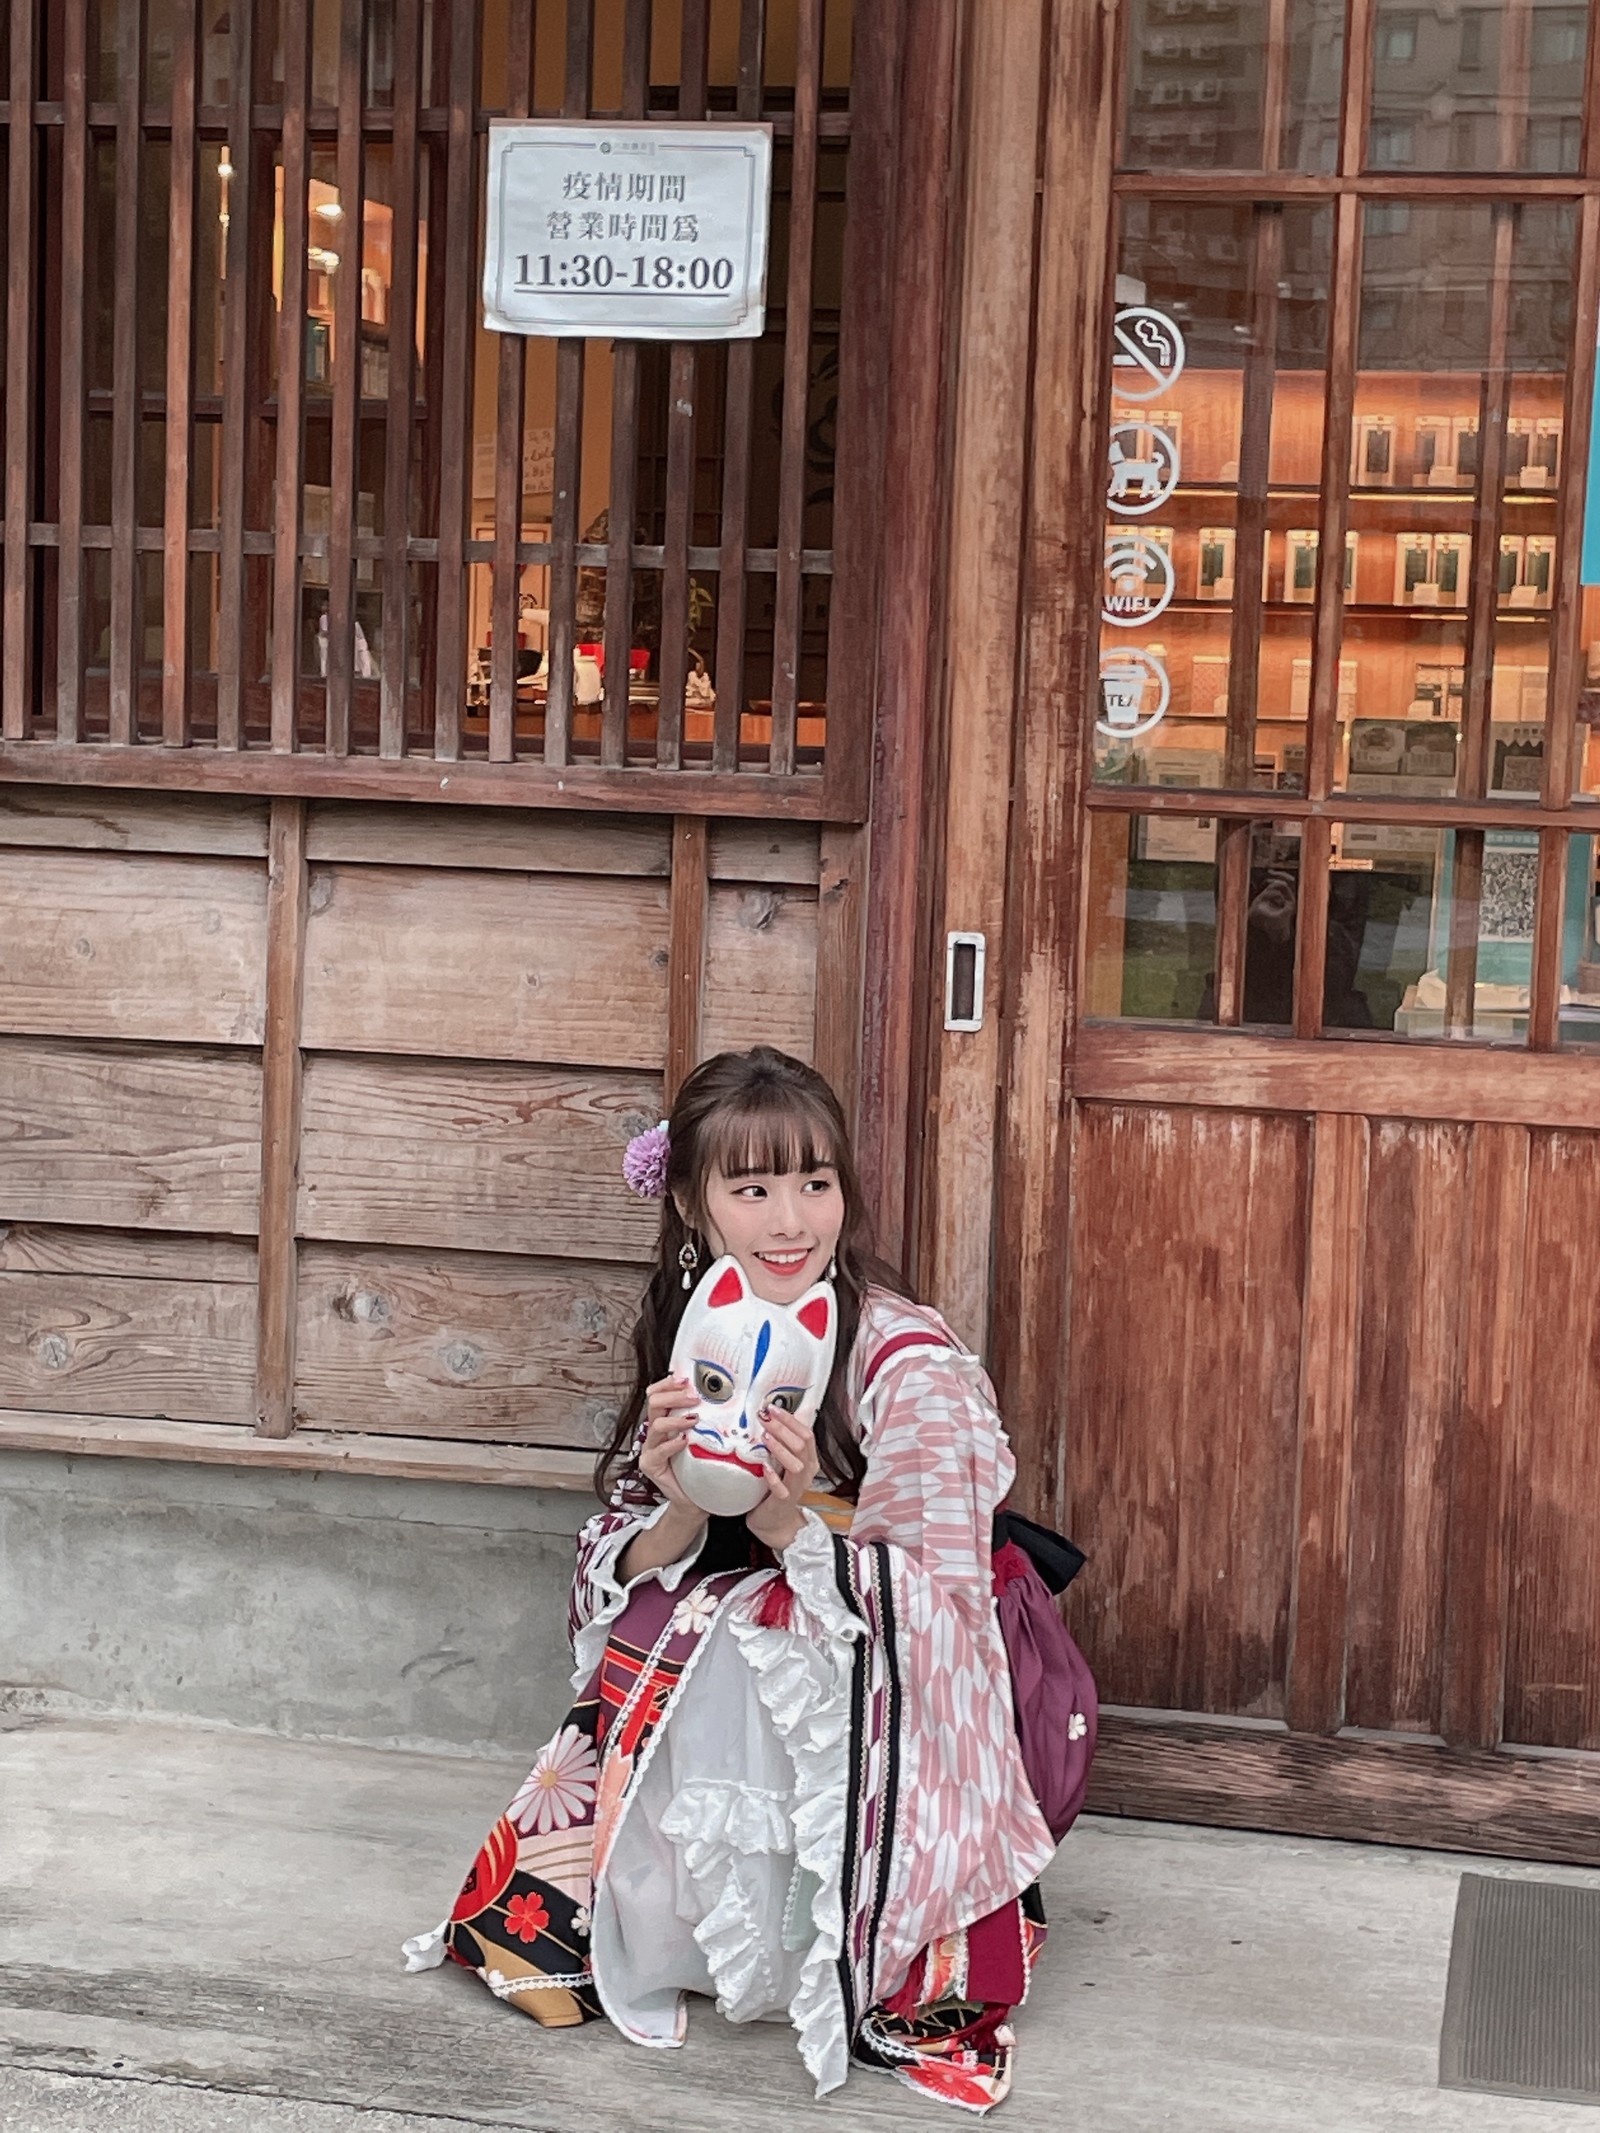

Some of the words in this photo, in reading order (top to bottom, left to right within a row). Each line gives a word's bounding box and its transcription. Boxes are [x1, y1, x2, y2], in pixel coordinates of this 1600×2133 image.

[562, 171, 687, 203] 疫情期間
[513, 254, 734, 290] 11:30-18:00
[1104, 595, 1151, 612] WIFI
